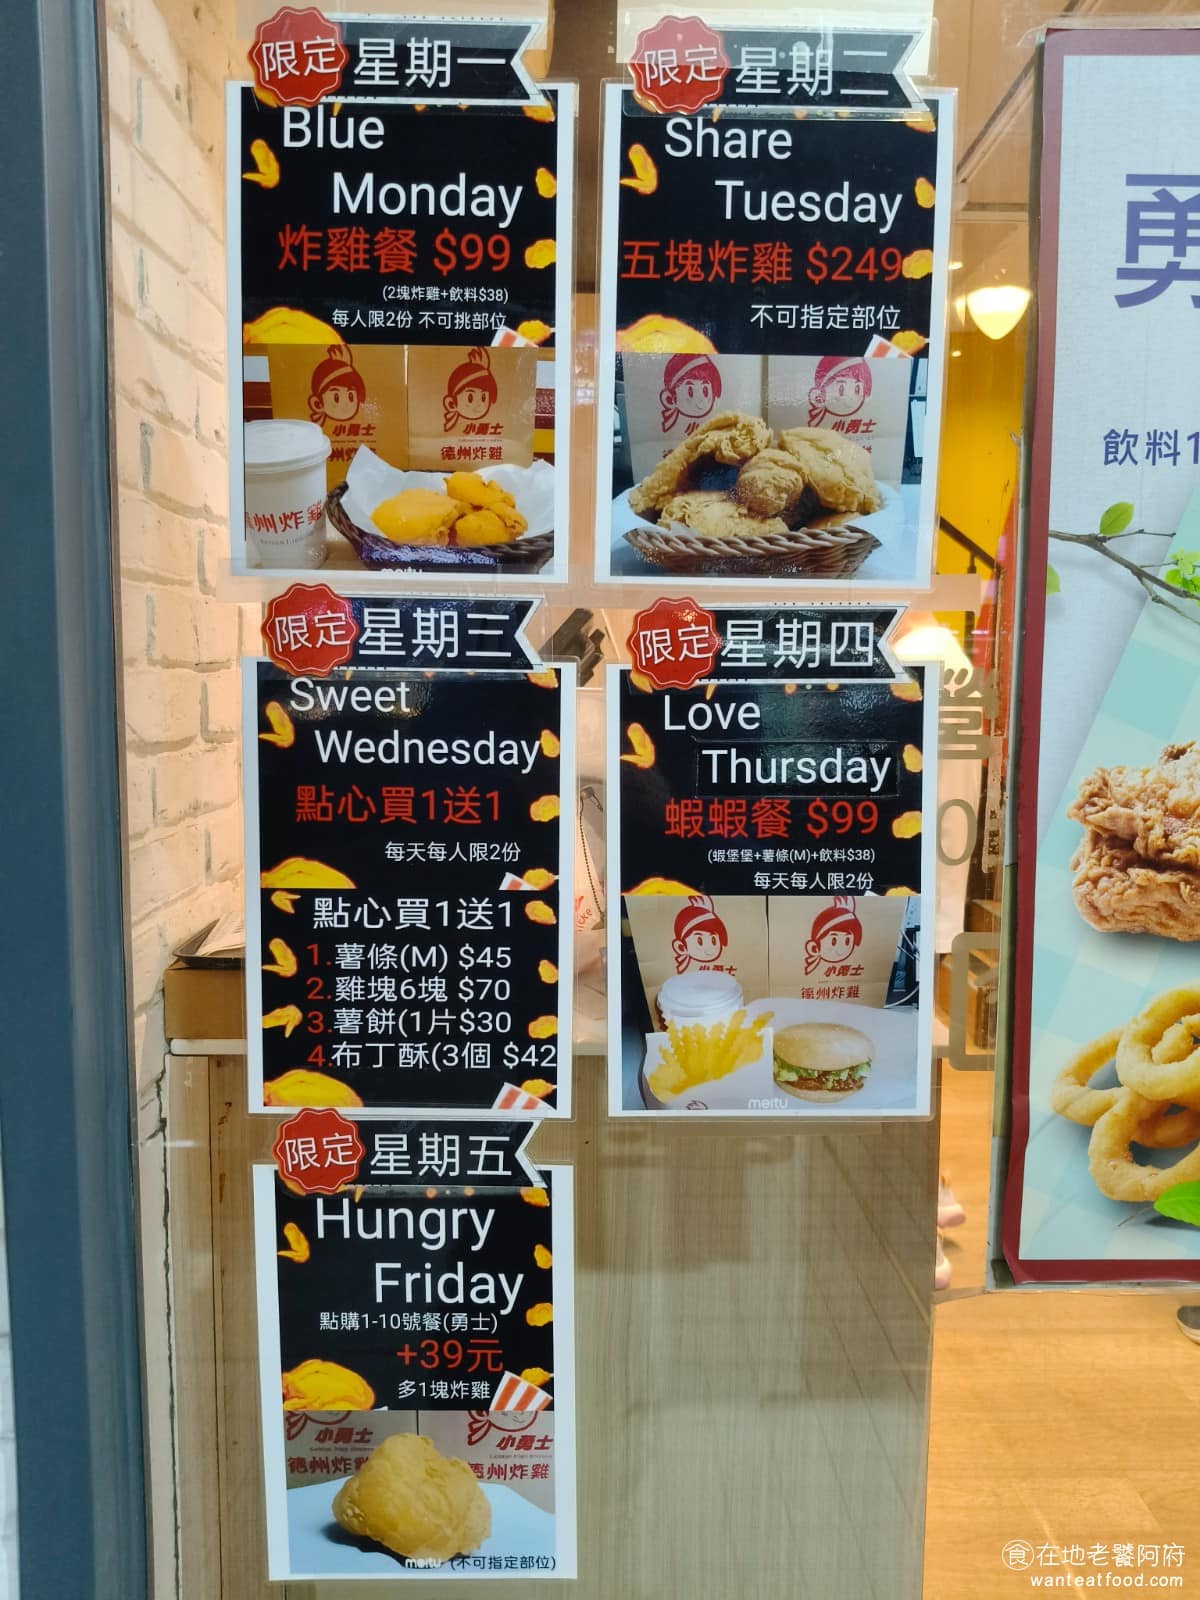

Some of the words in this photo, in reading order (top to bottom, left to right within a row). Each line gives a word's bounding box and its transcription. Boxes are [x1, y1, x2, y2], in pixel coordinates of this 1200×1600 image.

[262, 37, 341, 81] 限定
[353, 37, 506, 89] 星期一
[643, 45, 718, 88] 限定
[735, 46, 889, 97] 星期二
[283, 104, 385, 150] Blue
[664, 116, 793, 160] Share
[333, 172, 523, 229] Monday
[714, 180, 903, 234] Tuesday
[277, 224, 417, 274] 炸雞餐
[433, 227, 511, 277] $99
[620, 239, 792, 284] 五塊炸雞
[806, 241, 902, 285] $249
[382, 285, 509, 305] (2塊炸雞+飲料$38)
[332, 308, 413, 329] 每人限2份
[418, 311, 508, 332] 不可挑部位
[750, 303, 901, 331] 不可指定部位
[1103, 428, 1200, 467] 飲料1
[275, 610, 349, 652] 限定
[358, 607, 512, 659] 星期三
[639, 623, 710, 666] 限定
[720, 618, 874, 669] 星期四
[290, 677, 411, 713] Sweet
[663, 694, 761, 731] Love
[314, 729, 541, 774] Wednesday
[701, 748, 891, 793] Thursday
[295, 784, 499, 825] 點心買1送1
[664, 797, 792, 839] 蝦蝦餐
[806, 798, 879, 839] $99
[384, 841, 521, 862] 每天每人限2份
[707, 848, 876, 864] (蝦堡堡+薯條(M)+飲料$38)
[753, 871, 875, 891] 每天每人限2份
[313, 896, 512, 930] 點心買1送1
[458, 943, 512, 971] $45
[458, 975, 511, 1002] $70
[503, 1041, 557, 1070] $42
[285, 1132, 357, 1172] 限定
[370, 1132, 512, 1177] 星期五
[316, 1197, 496, 1252] Hungry
[375, 1261, 524, 1316] Friday
[319, 1311, 498, 1334] 點購1-10號餐(勇士)
[396, 1338, 504, 1373] +39元
[398, 1379, 491, 1400] 多1塊炸雞
[450, 1555, 557, 1571] (不可指定部位)
